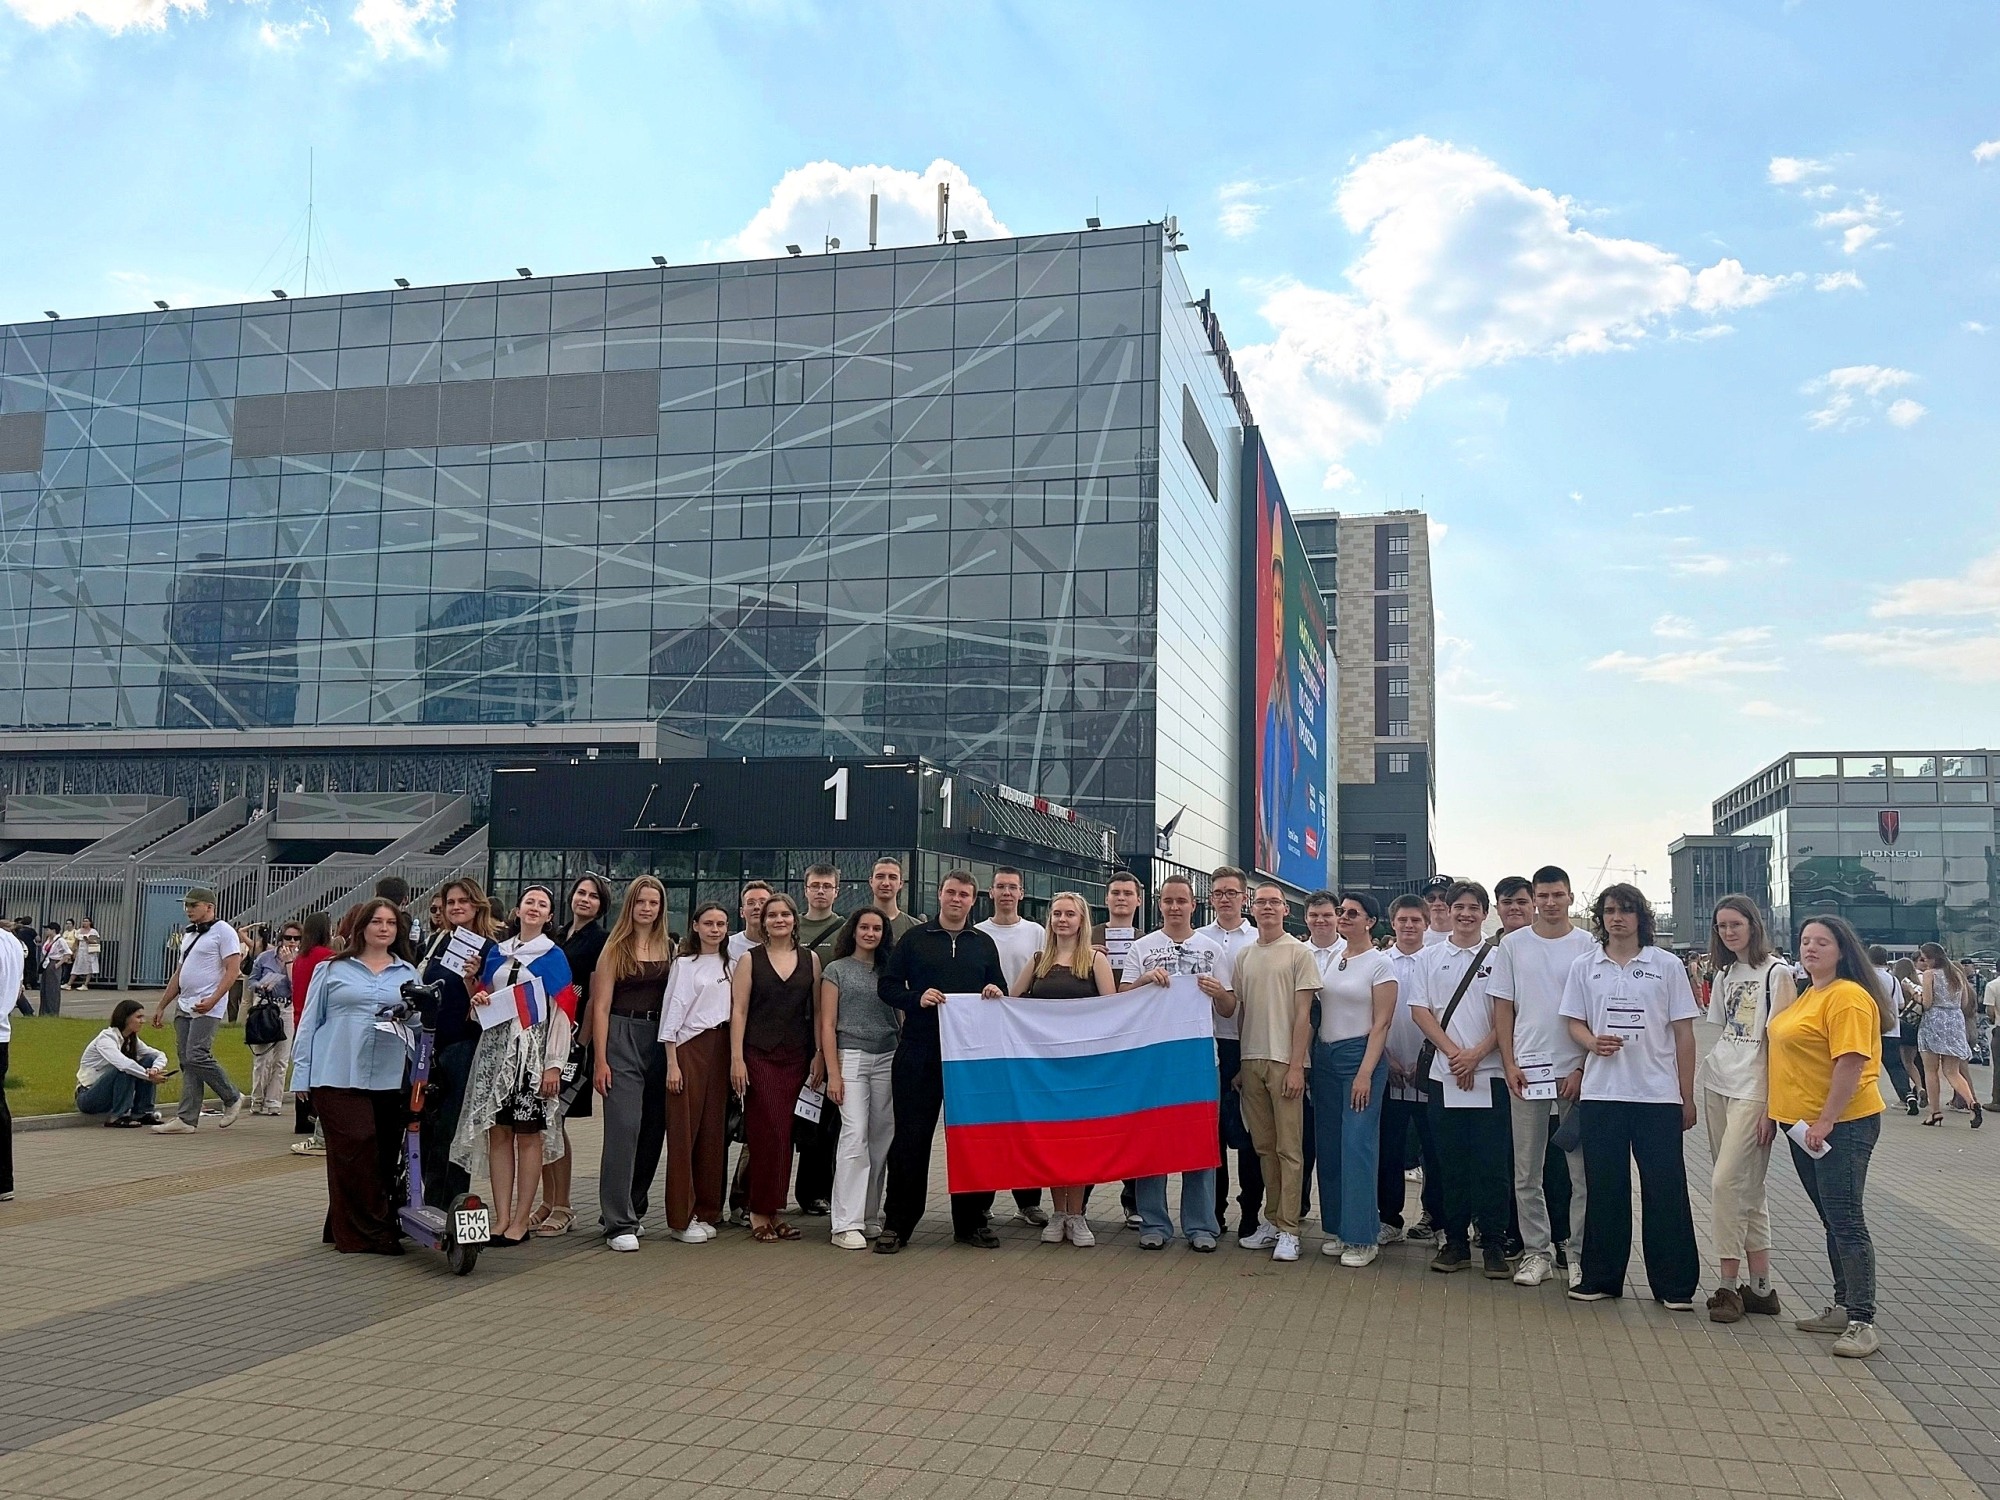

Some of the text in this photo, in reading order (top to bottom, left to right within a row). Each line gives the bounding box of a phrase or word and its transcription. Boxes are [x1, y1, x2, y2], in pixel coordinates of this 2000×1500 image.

[824, 767, 849, 820] 1
[939, 777, 953, 829] 1
[1860, 849, 1923, 857] HONGQI
[457, 1210, 486, 1225] EM4
